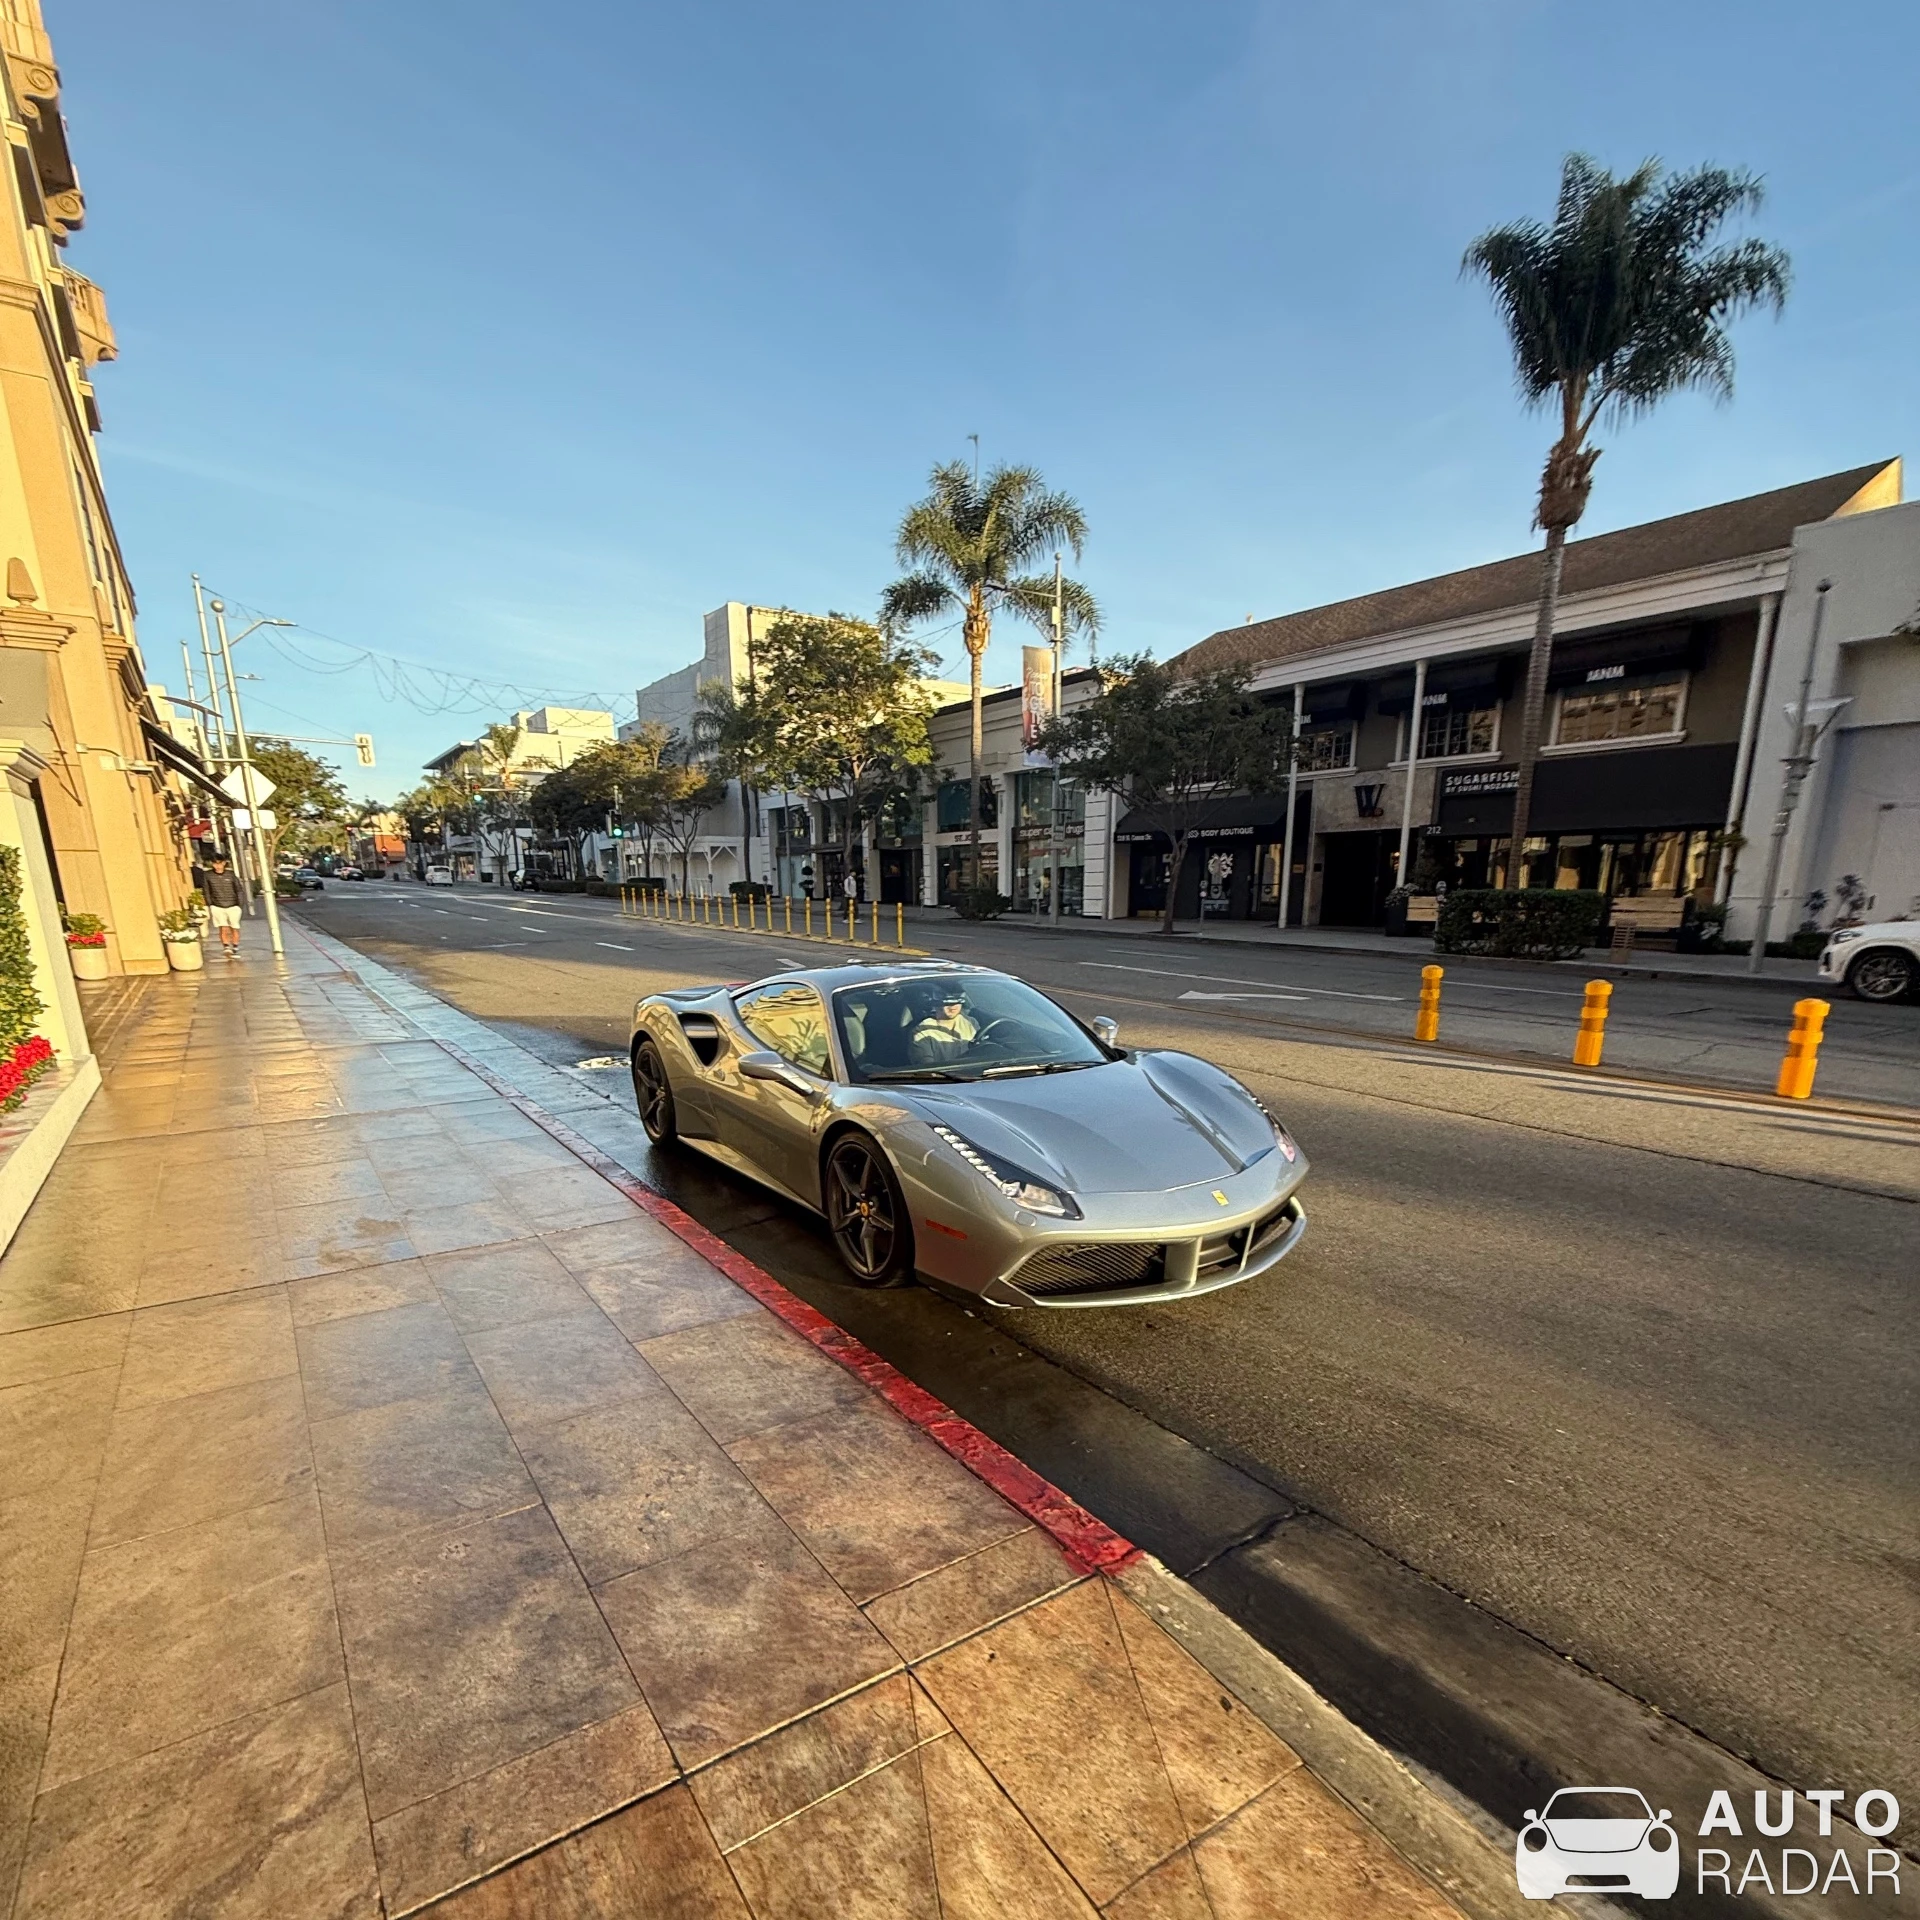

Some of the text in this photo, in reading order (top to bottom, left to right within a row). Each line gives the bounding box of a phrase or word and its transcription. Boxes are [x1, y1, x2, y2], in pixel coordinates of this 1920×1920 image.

[1446, 771, 1521, 786] SUGARFISH
[1019, 828, 1042, 838] super
[1065, 824, 1084, 835] drugs
[1219, 826, 1254, 836] BOUTIQUE
[1426, 826, 1442, 835] 212
